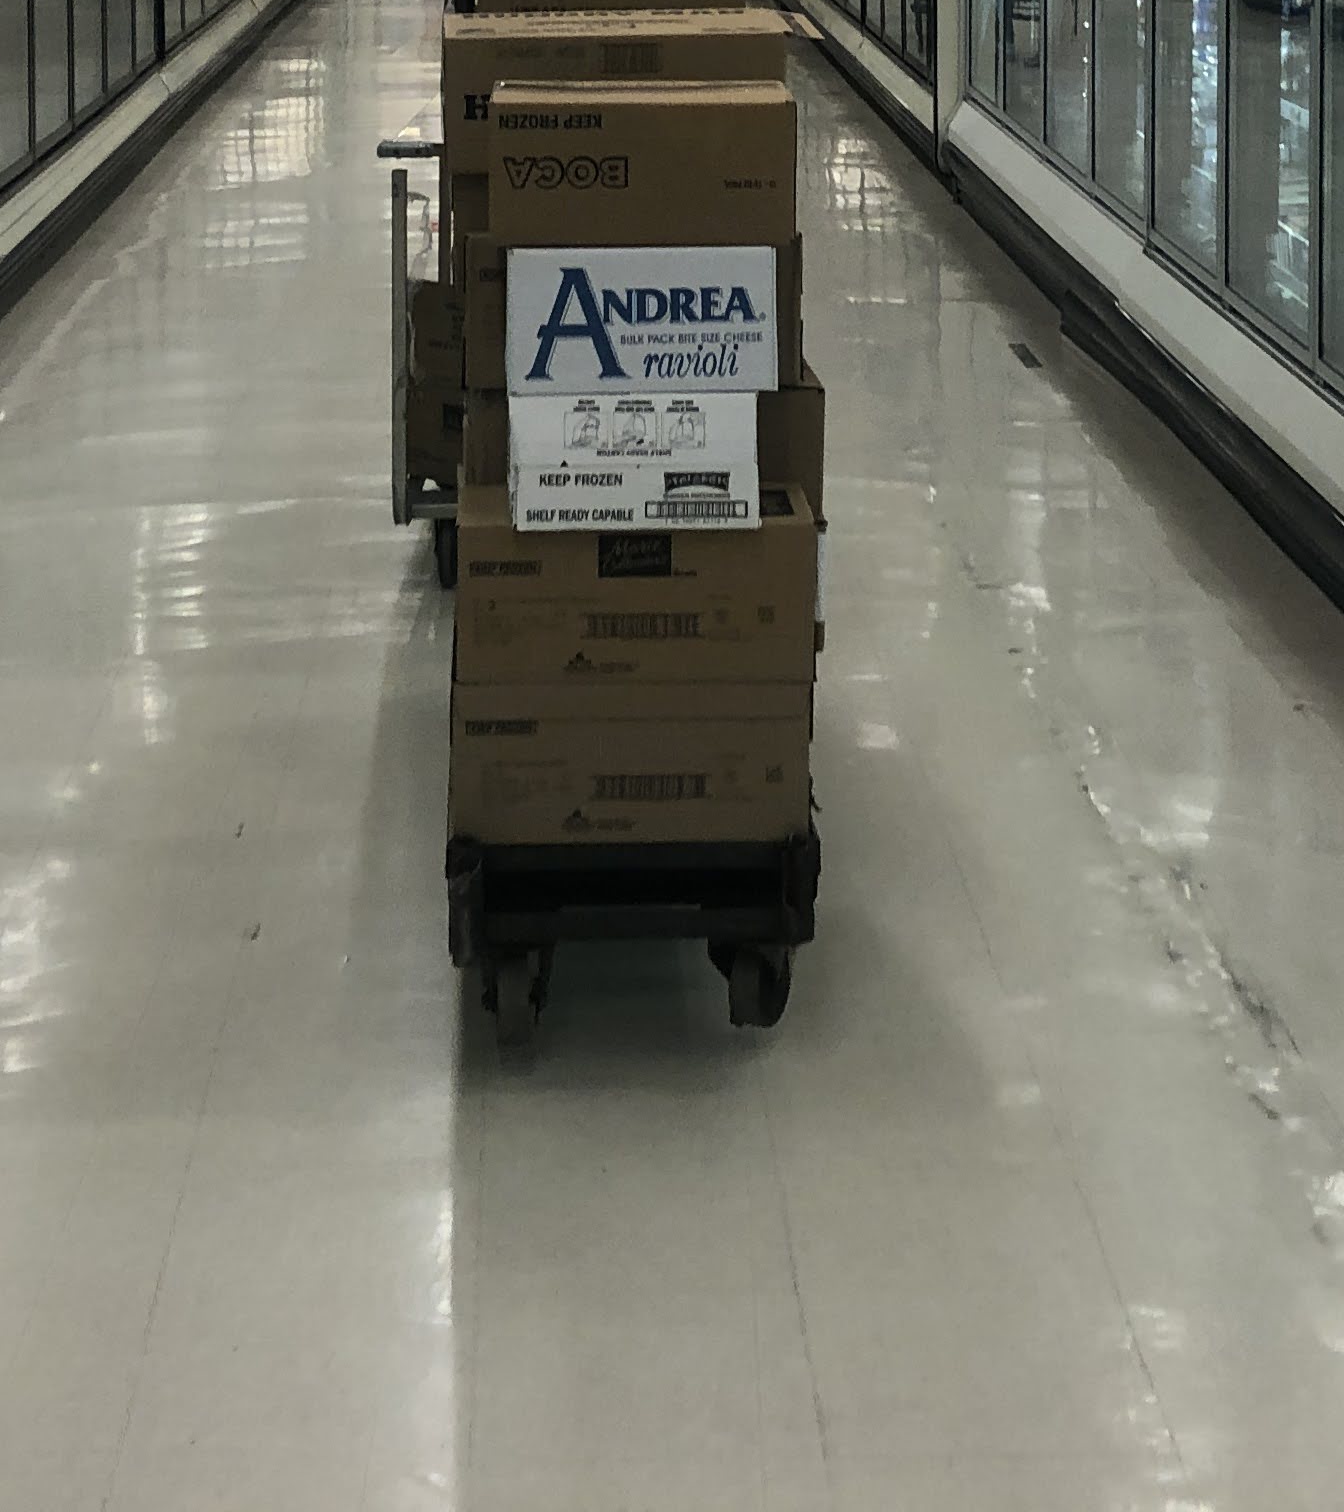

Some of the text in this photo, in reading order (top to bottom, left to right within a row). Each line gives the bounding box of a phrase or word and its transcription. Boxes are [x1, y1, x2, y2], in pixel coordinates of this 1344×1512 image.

[498, 113, 603, 130] KEEP FROZEN
[503, 156, 629, 189] BOCA
[524, 267, 759, 381] ANDREA
[620, 331, 764, 345] BULK PACK BITE SIZE CHEESE
[643, 342, 740, 379] ravioli
[538, 473, 623, 487] KEEP FROZEN
[526, 508, 634, 522] SHELF READY CAPABLE
